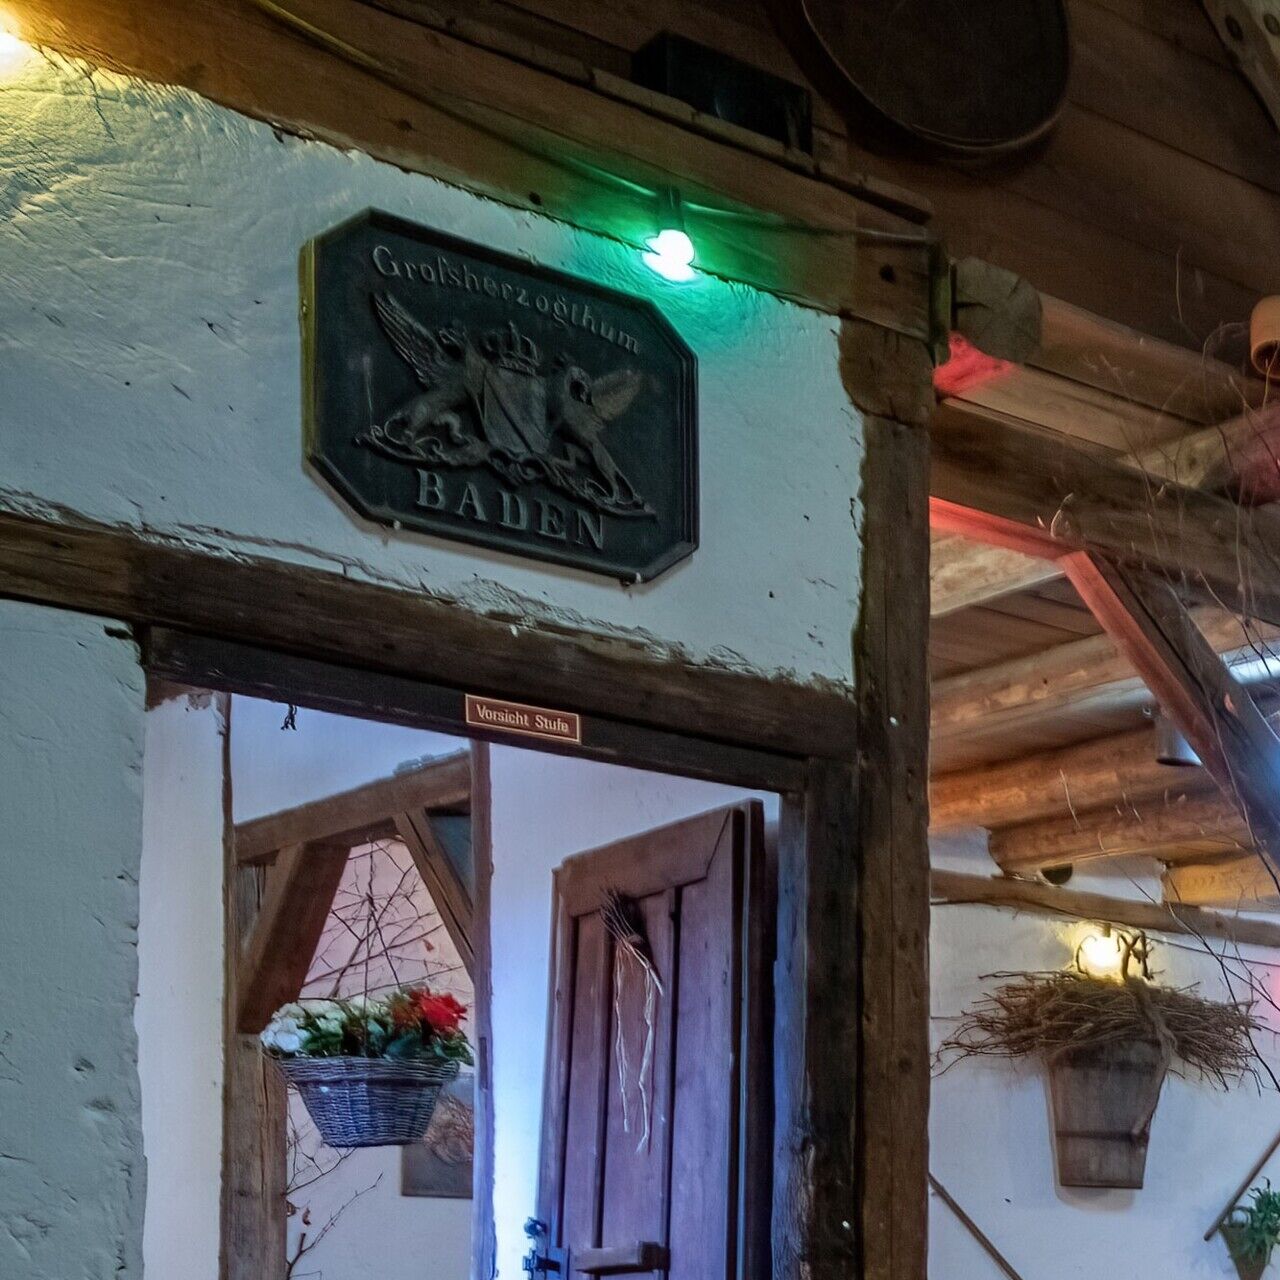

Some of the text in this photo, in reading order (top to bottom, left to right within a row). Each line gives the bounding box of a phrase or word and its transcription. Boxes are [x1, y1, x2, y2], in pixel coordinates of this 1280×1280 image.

[416, 468, 604, 550] BADEN
[476, 704, 569, 733] Vorsicht Stufe
